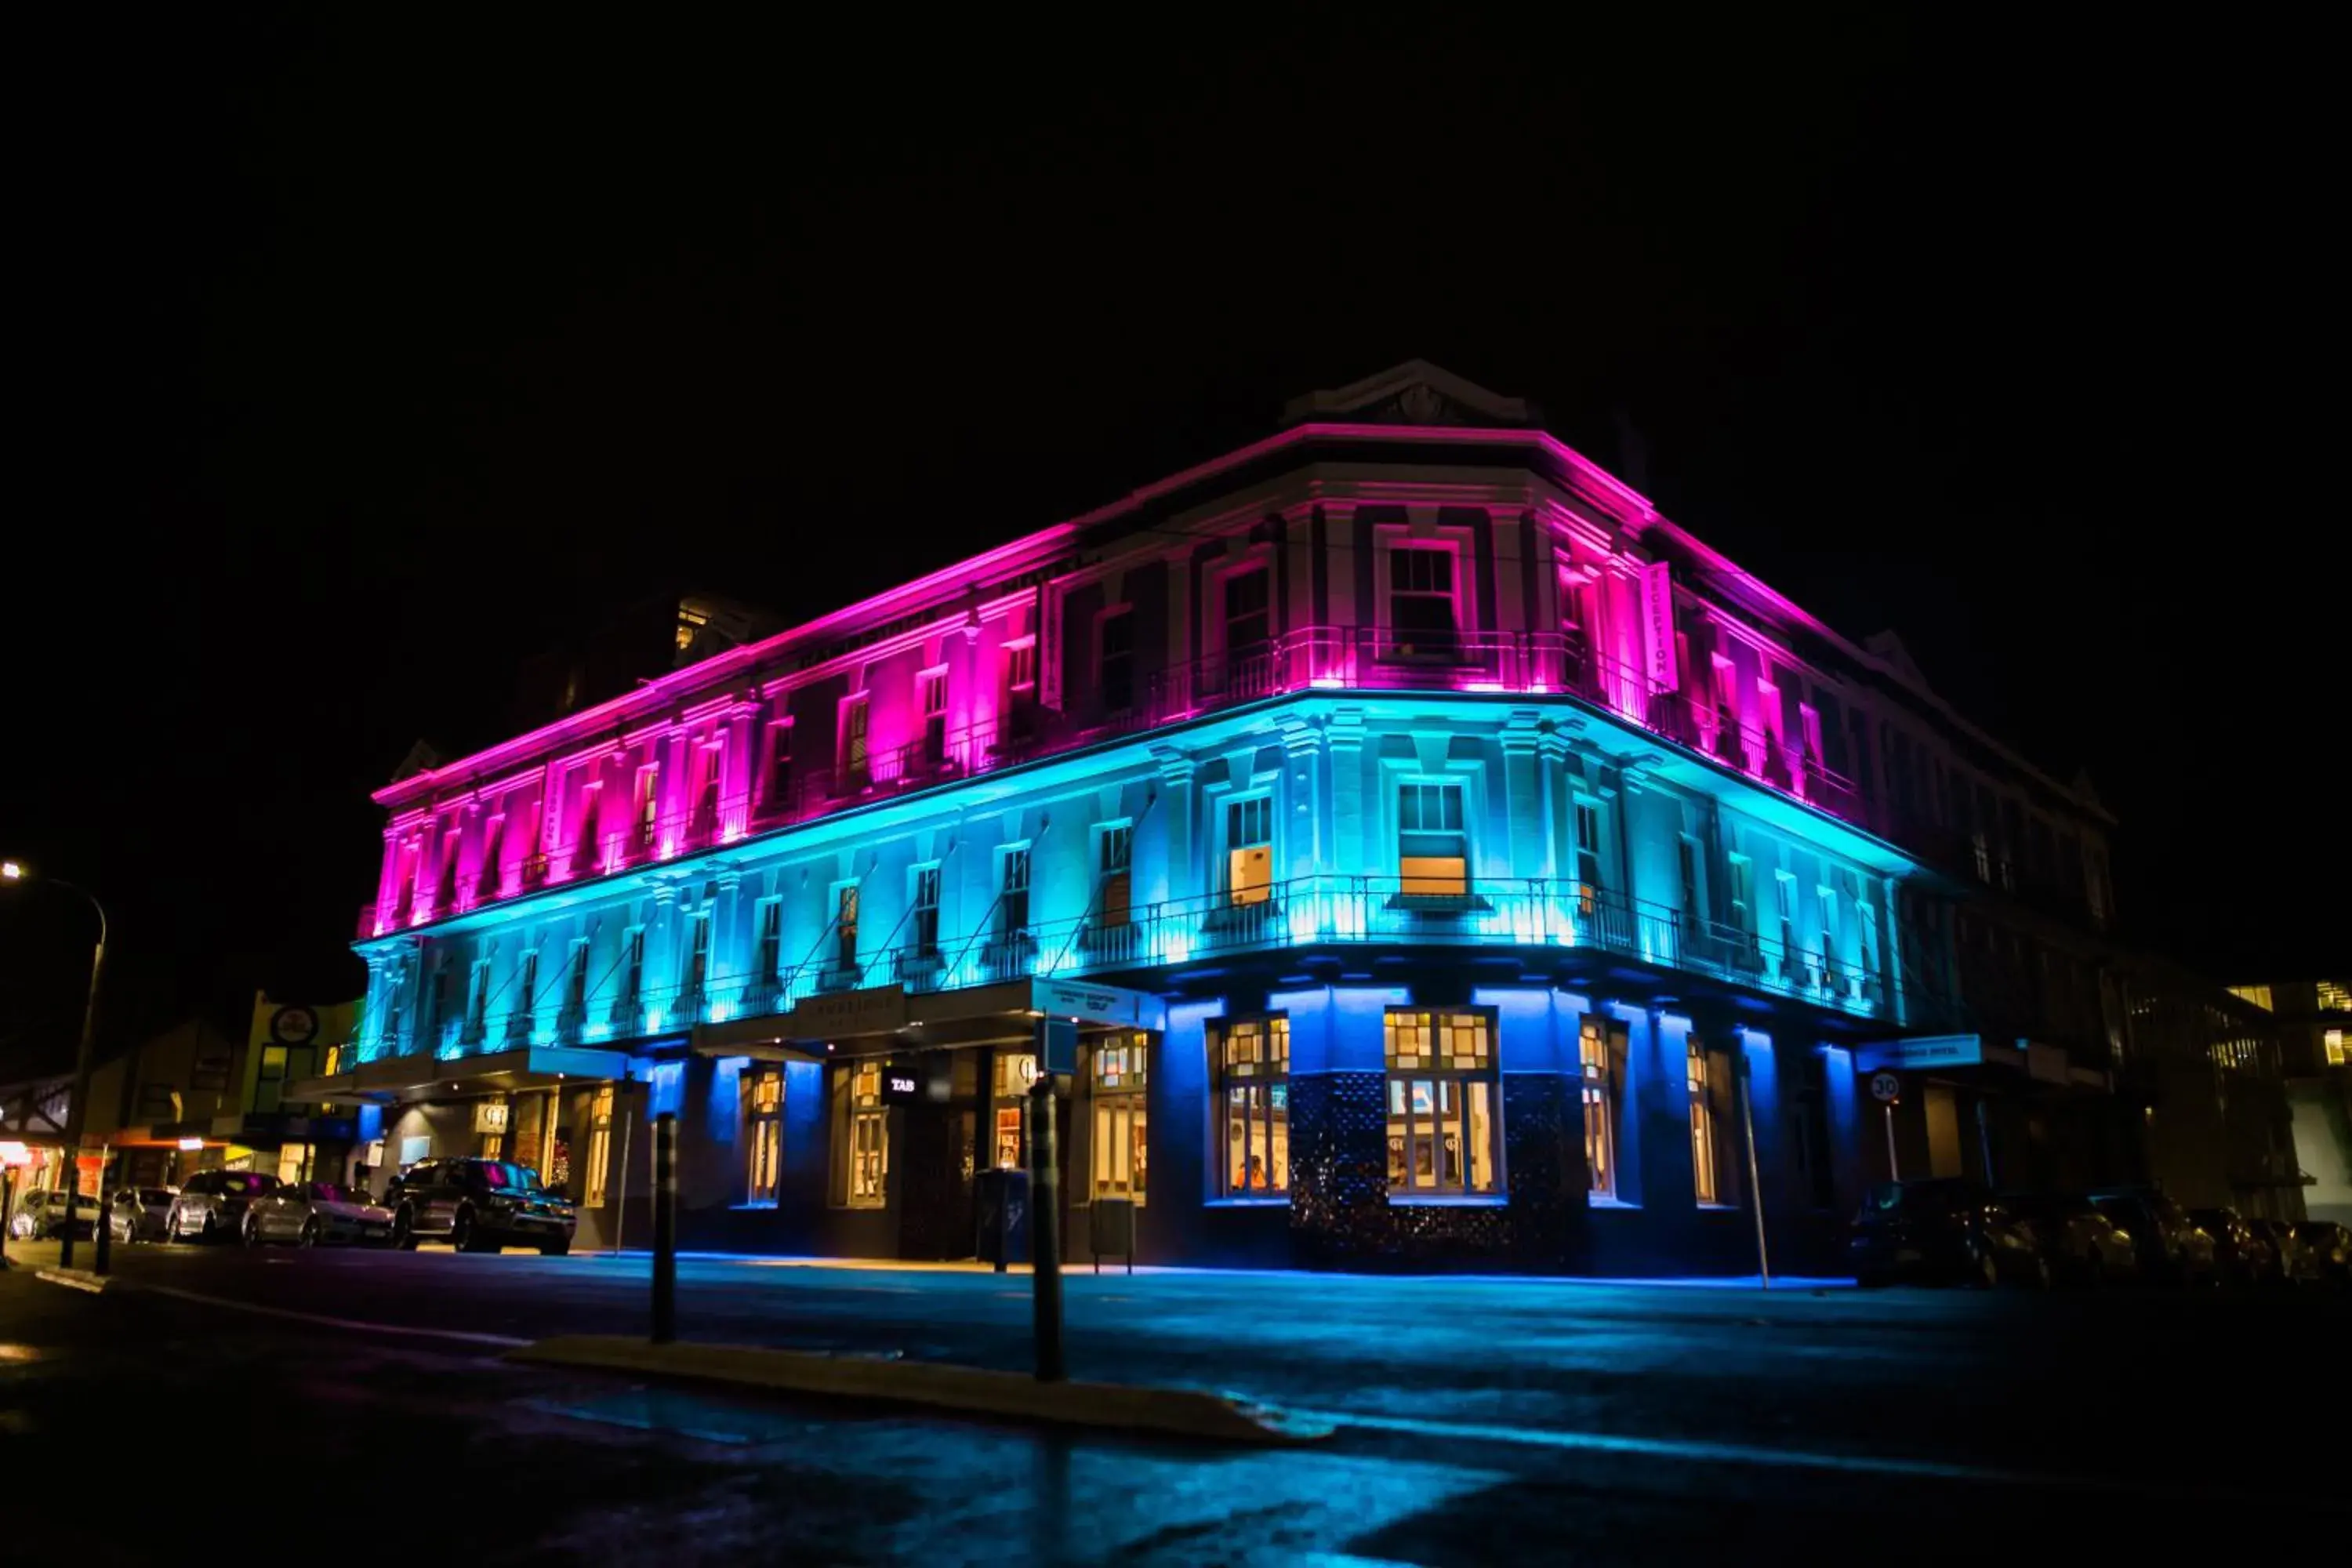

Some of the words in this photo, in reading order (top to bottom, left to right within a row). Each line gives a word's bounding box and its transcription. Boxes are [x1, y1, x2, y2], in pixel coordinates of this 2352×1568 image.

[1650, 569, 1668, 672] RECEPTION
[891, 1077, 916, 1092] TAB
[1875, 1079, 1896, 1094] 30
